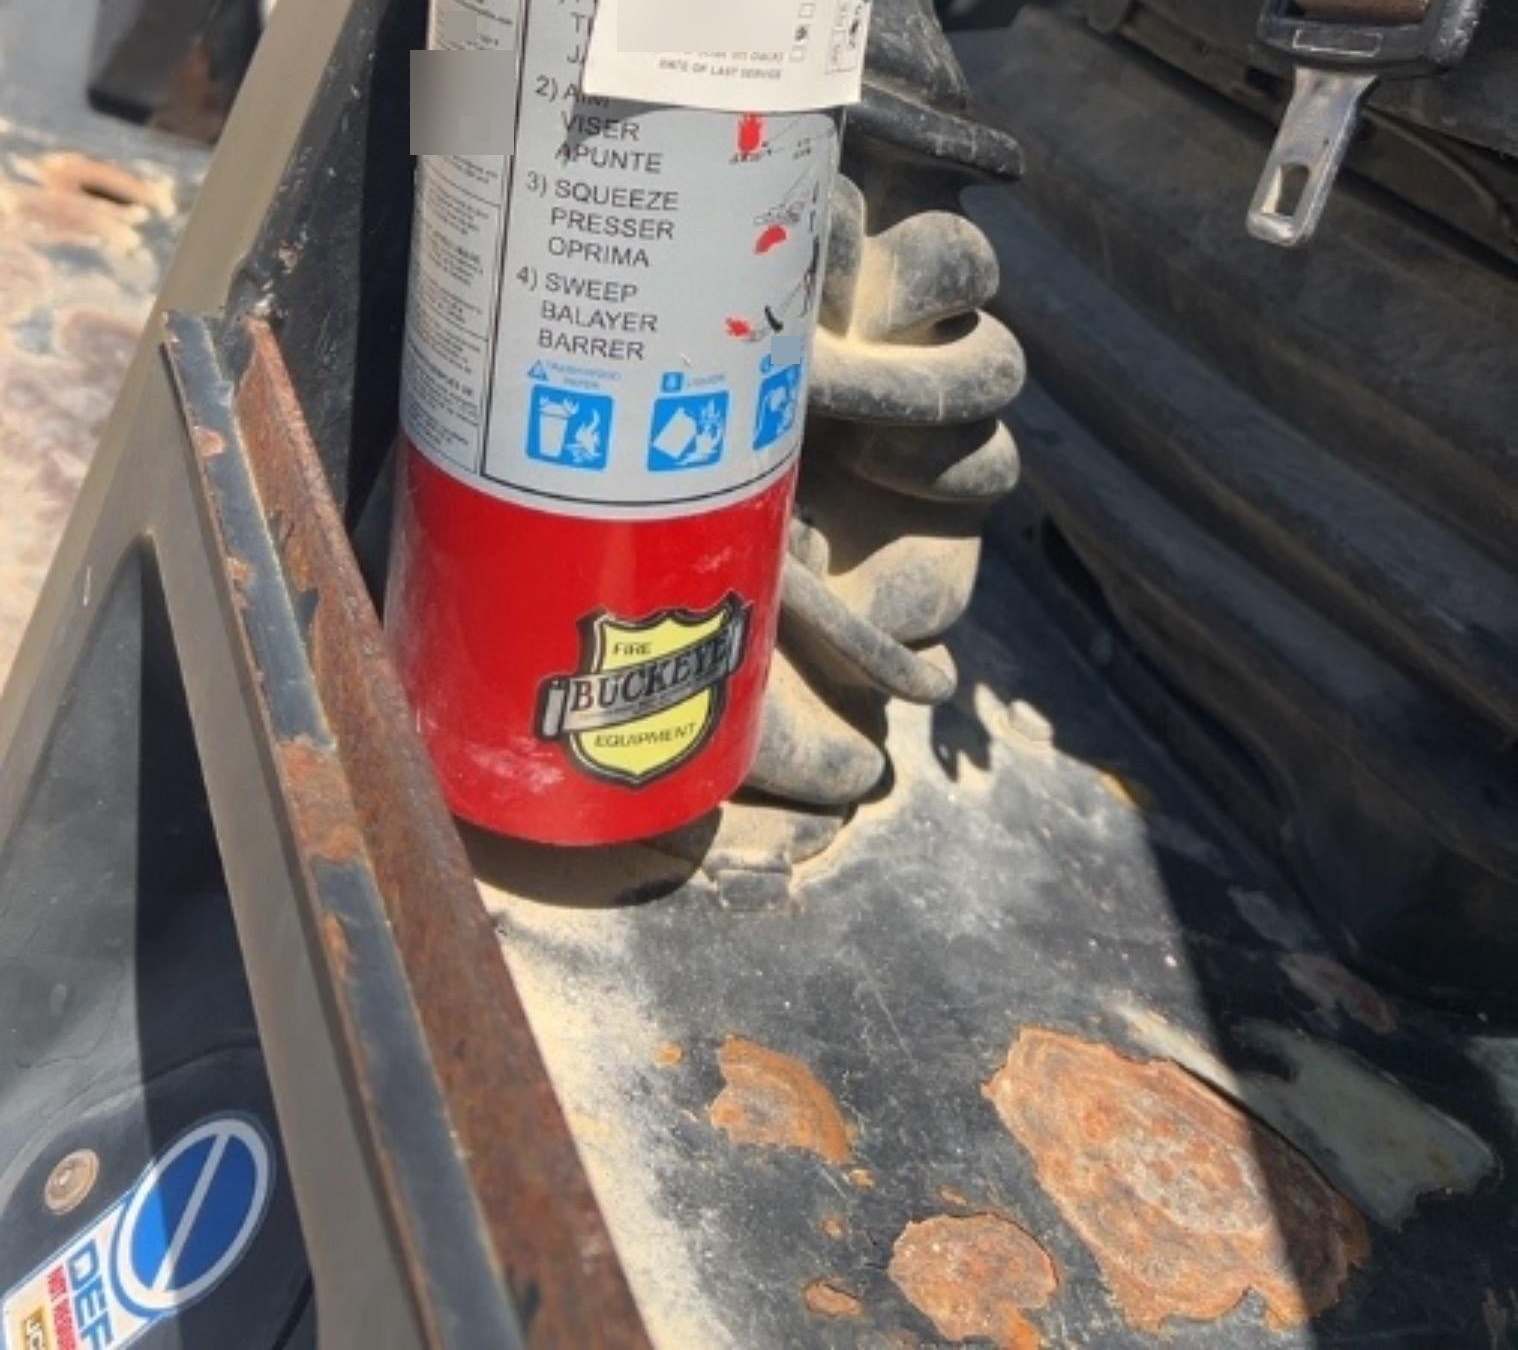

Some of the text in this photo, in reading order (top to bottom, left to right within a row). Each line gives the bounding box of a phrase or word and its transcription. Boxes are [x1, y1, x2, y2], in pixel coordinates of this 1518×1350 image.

[535, 74, 559, 102] 2)
[561, 109, 640, 142] VISER
[554, 142, 664, 175] APUNTE
[526, 170, 547, 199] 3)
[554, 178, 679, 212] SQUEEZE
[550, 206, 675, 241] PRESSER
[547, 236, 650, 268] OPRIMA
[515, 265, 638, 301] 4) SWEEP
[541, 299, 659, 333] BALAYER
[537, 328, 646, 361] BARRER
[613, 642, 652, 656] FIRE
[568, 636, 730, 712] BUCKEYE
[593, 722, 697, 749] EQUIPMENT
[66, 1238, 114, 1350] DEF
